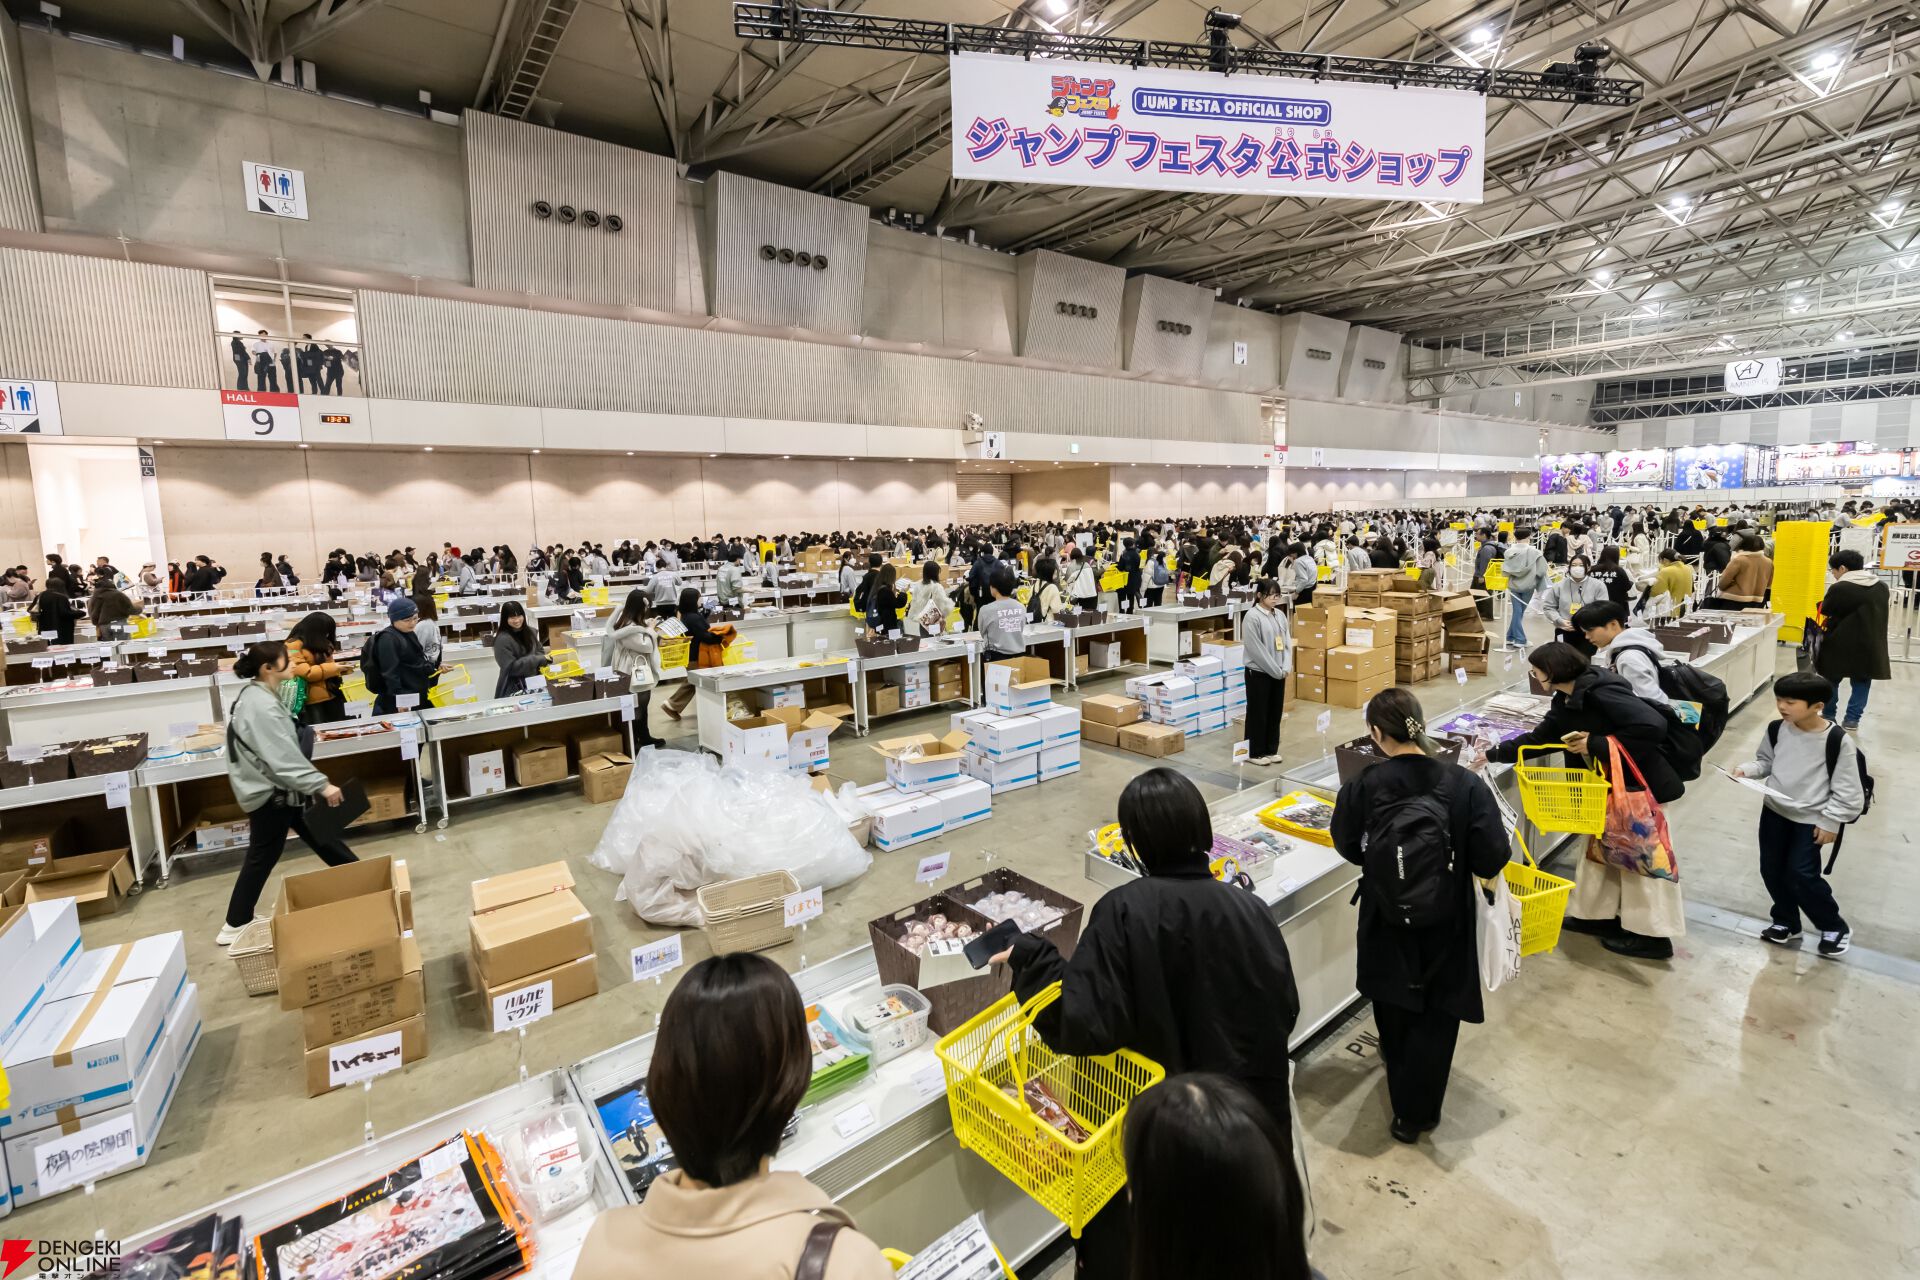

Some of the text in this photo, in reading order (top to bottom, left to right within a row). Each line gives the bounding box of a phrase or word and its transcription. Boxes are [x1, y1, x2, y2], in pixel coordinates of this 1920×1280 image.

[1141, 94, 1323, 120] JUMP FESTA OFFICIAL SHOP
[965, 117, 1473, 187] ジャンプフェスタ公式ショップ
[226, 393, 257, 403] HALL
[251, 408, 275, 436] 9
[1278, 452, 1284, 464] 9
[997, 609, 1023, 617] STAFF
[1397, 845, 1405, 880] SALOMON
[505, 987, 544, 1010] ハルカゼ
[507, 1001, 541, 1022] マウンド
